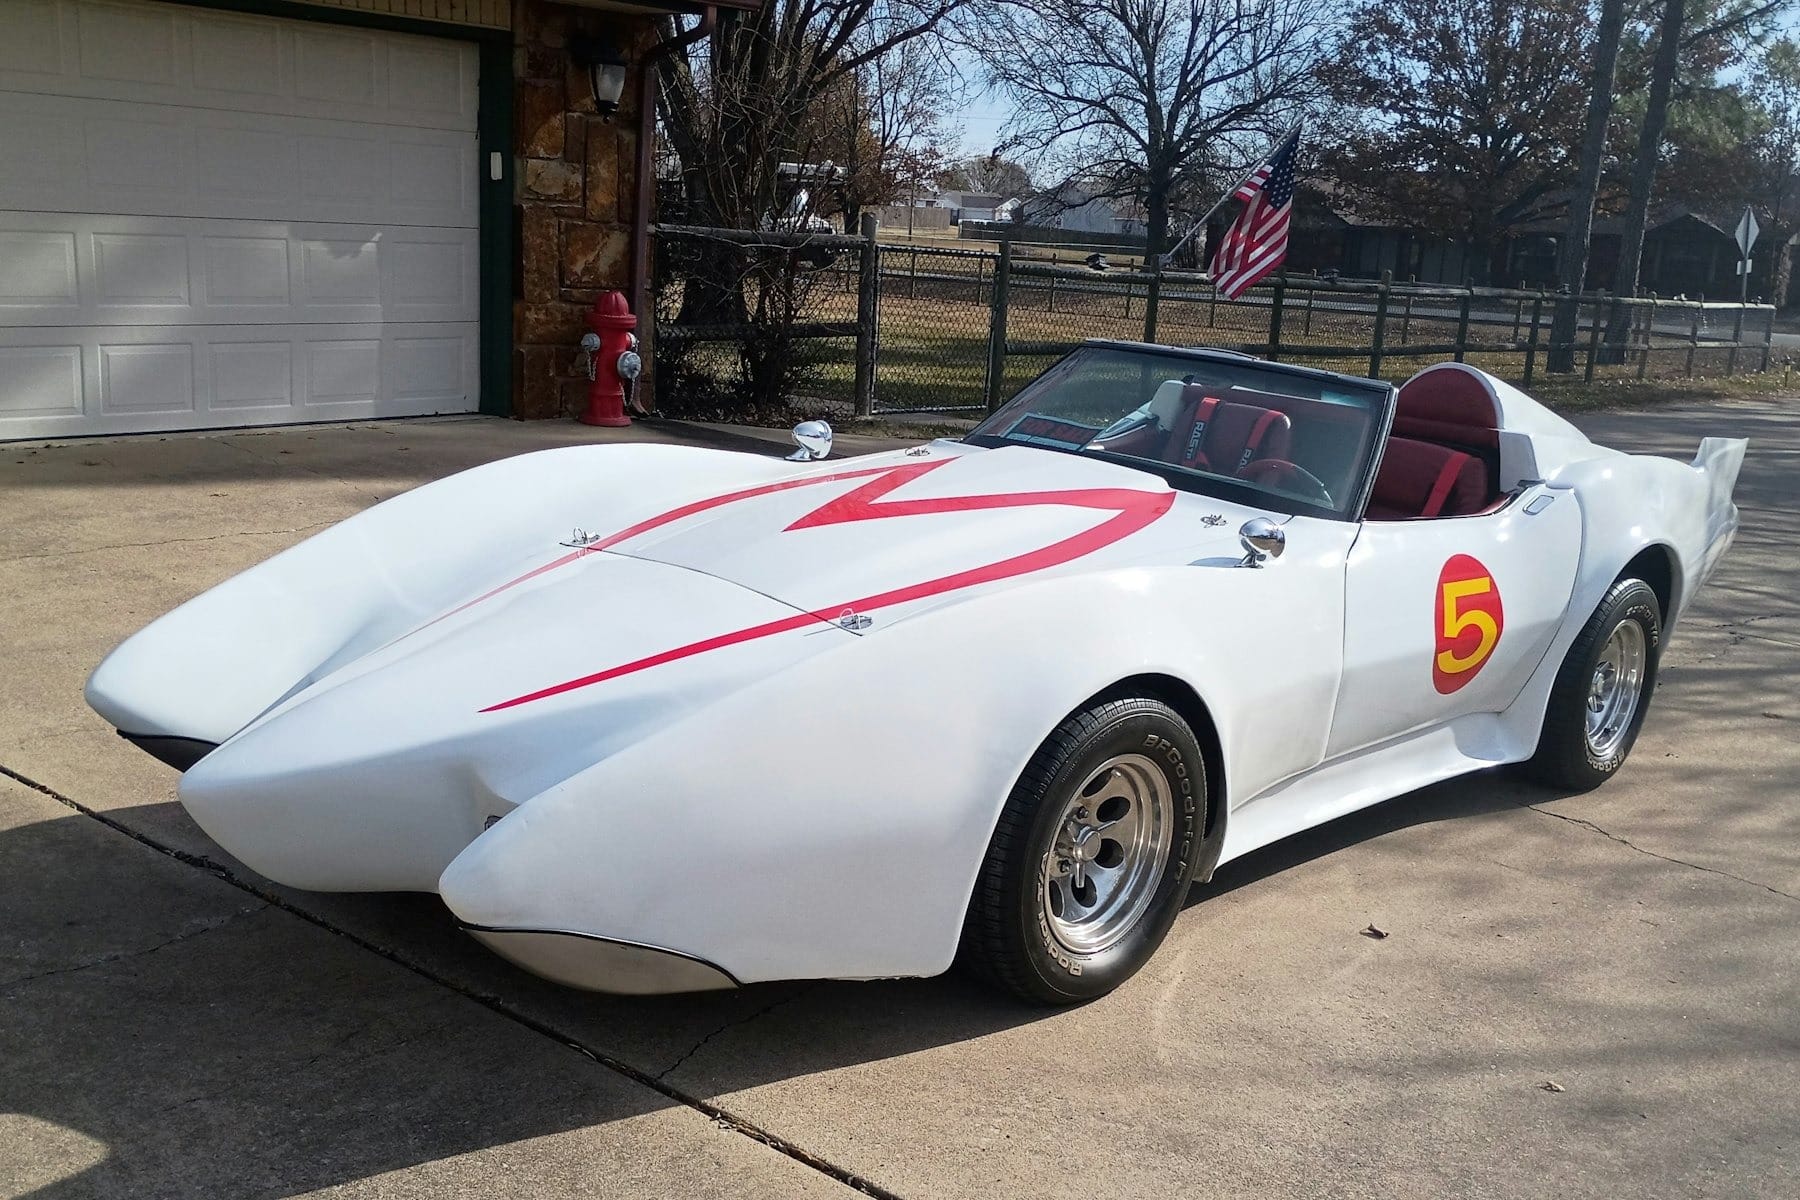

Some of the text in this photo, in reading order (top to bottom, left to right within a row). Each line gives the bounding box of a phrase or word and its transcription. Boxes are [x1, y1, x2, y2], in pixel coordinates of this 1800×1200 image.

[1437, 576, 1498, 674] 5
[1143, 734, 1195, 885] BFGoodrich
[1038, 911, 1082, 977] Radial
